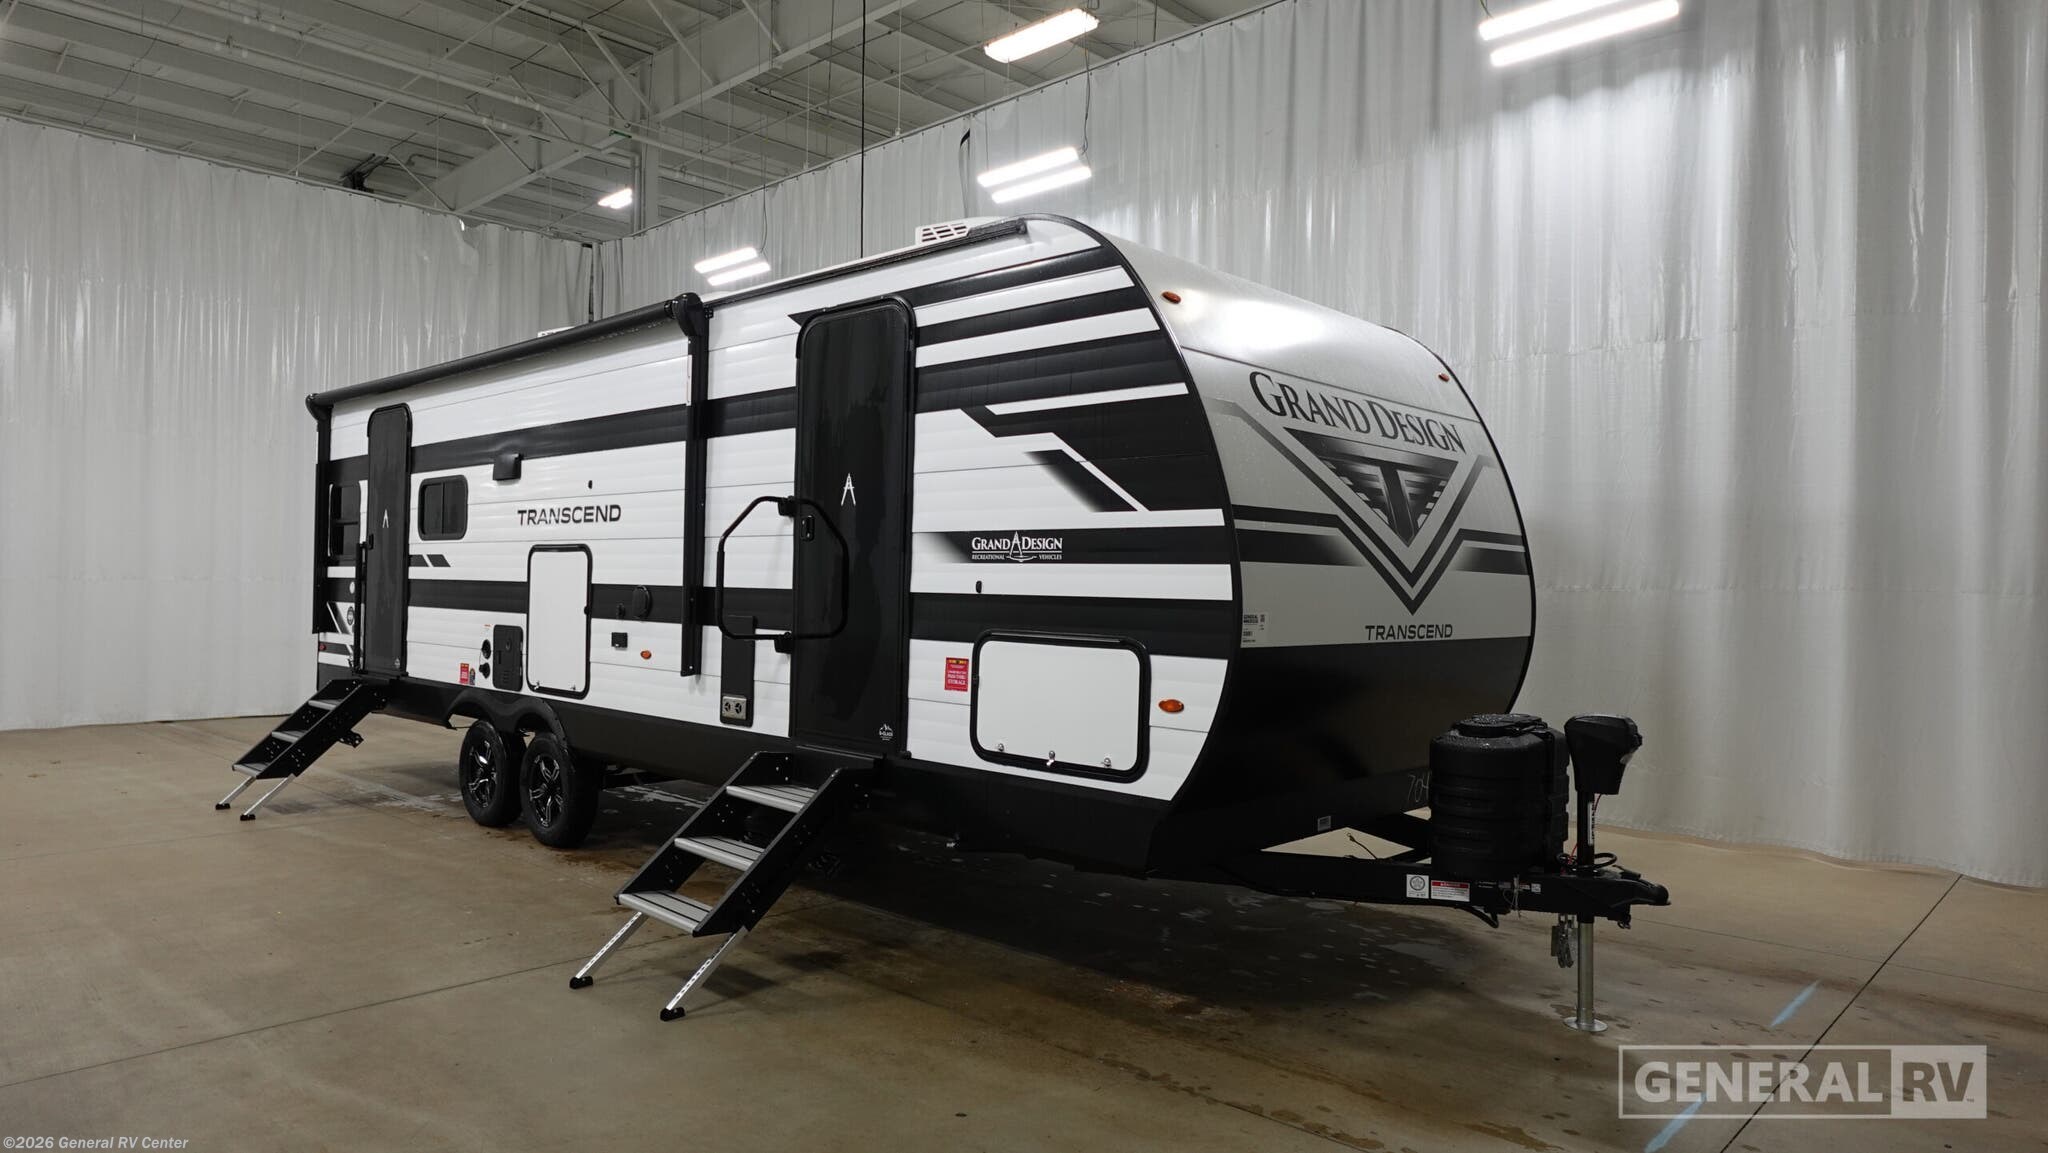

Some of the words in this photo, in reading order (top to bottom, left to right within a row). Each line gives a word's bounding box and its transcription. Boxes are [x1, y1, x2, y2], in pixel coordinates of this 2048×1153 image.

[1249, 371, 1371, 434] GRAND
[1365, 400, 1467, 454] DESIGN
[517, 504, 622, 526] TRANSCEND
[971, 536, 1011, 551] GRAND
[1021, 536, 1063, 550] DESIGN
[1364, 623, 1453, 641] TRANSCEND
